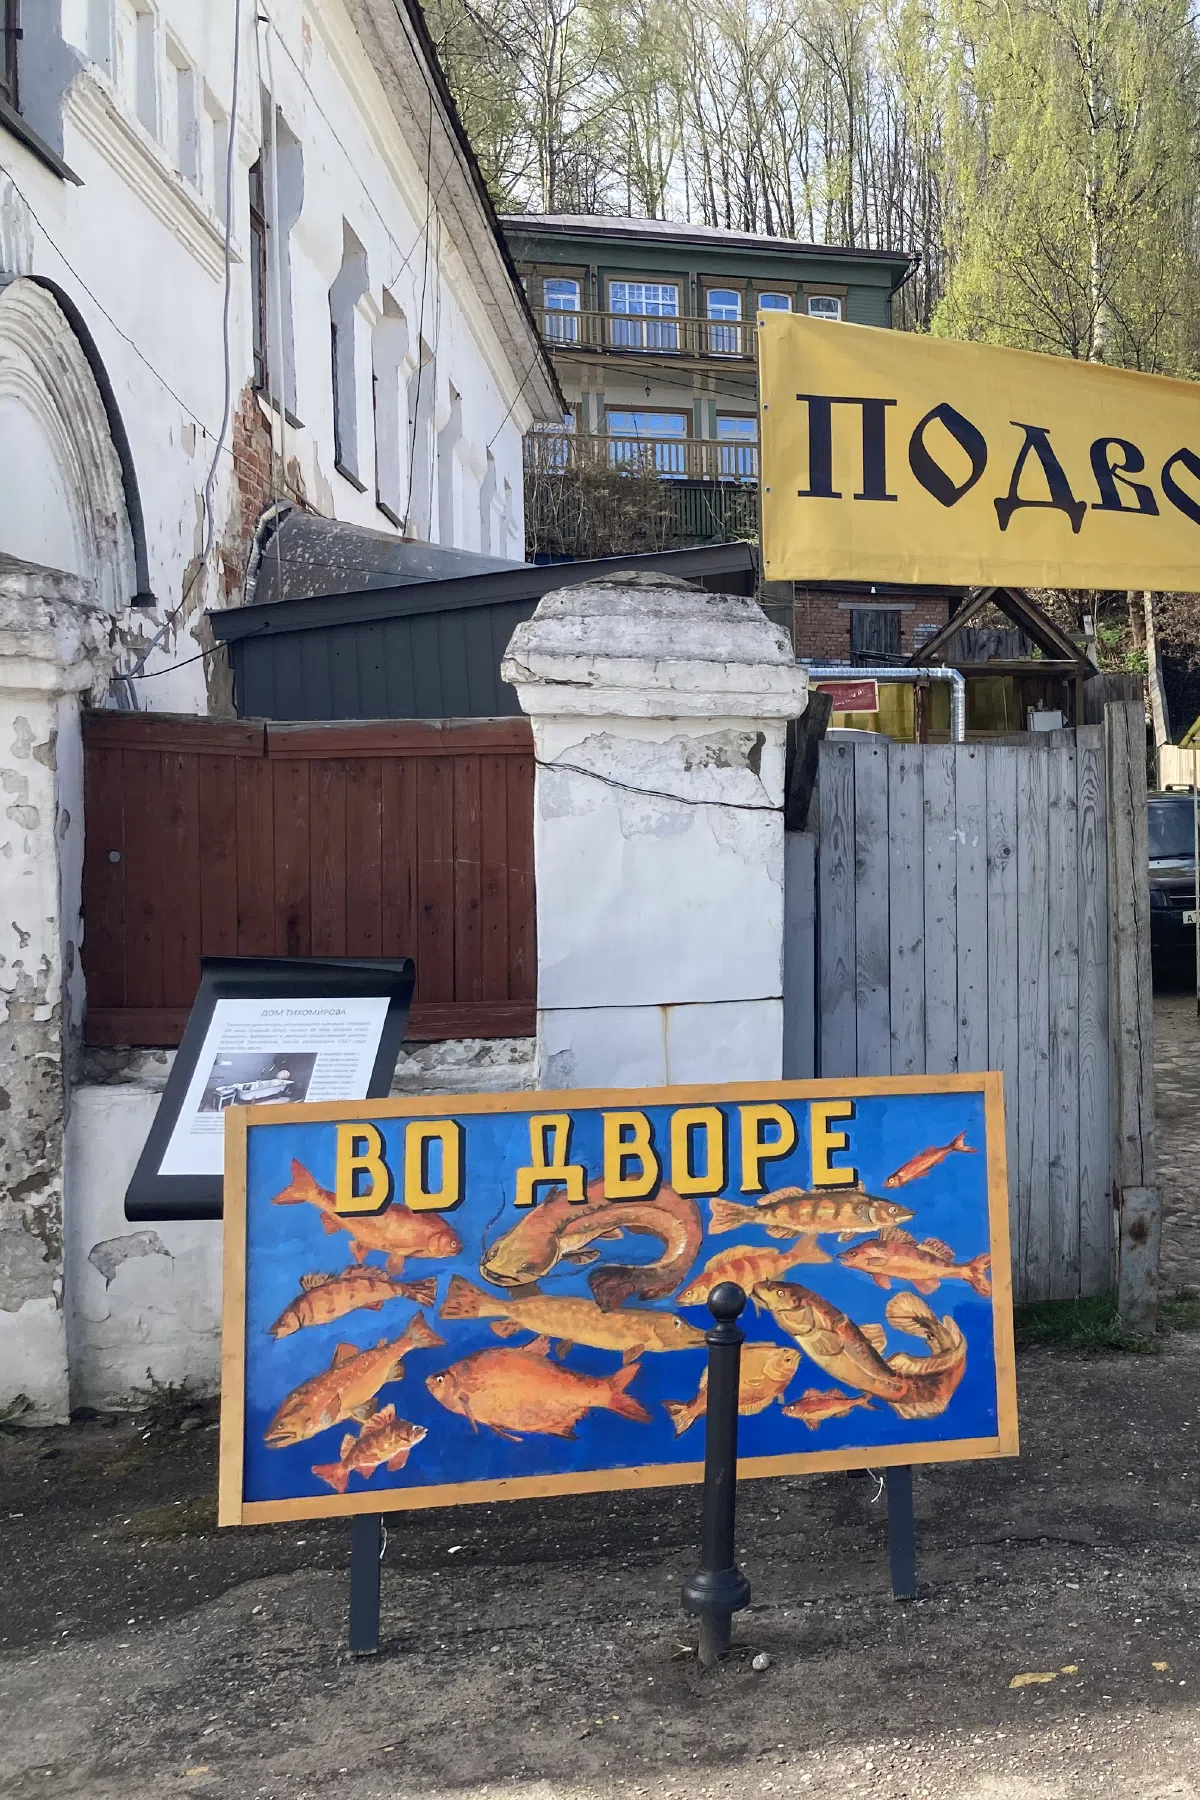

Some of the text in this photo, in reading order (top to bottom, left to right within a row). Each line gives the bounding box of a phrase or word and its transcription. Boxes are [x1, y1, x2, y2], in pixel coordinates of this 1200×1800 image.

[260, 1008, 347, 1017] ДОМ ТИХОМИРОВА
[335, 1100, 862, 1216] ВО ДВОРЕ
